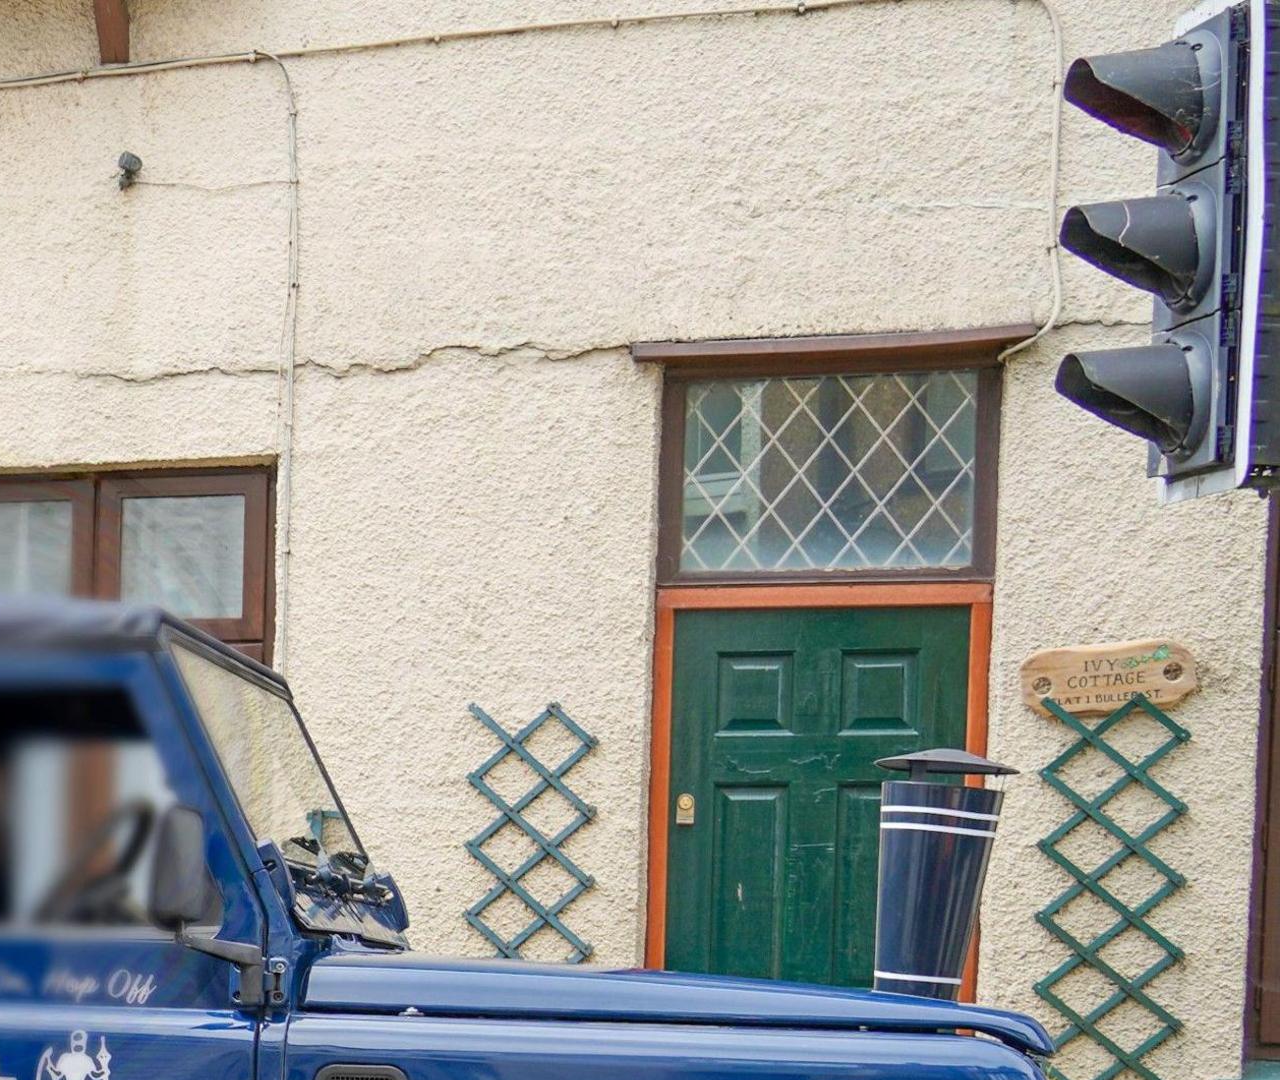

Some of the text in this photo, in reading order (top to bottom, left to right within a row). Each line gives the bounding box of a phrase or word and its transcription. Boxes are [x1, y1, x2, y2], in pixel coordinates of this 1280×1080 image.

[1084, 658, 1119, 673] IVY
[1067, 671, 1146, 689] COTTAGE
[107, 968, 159, 1005] Off
